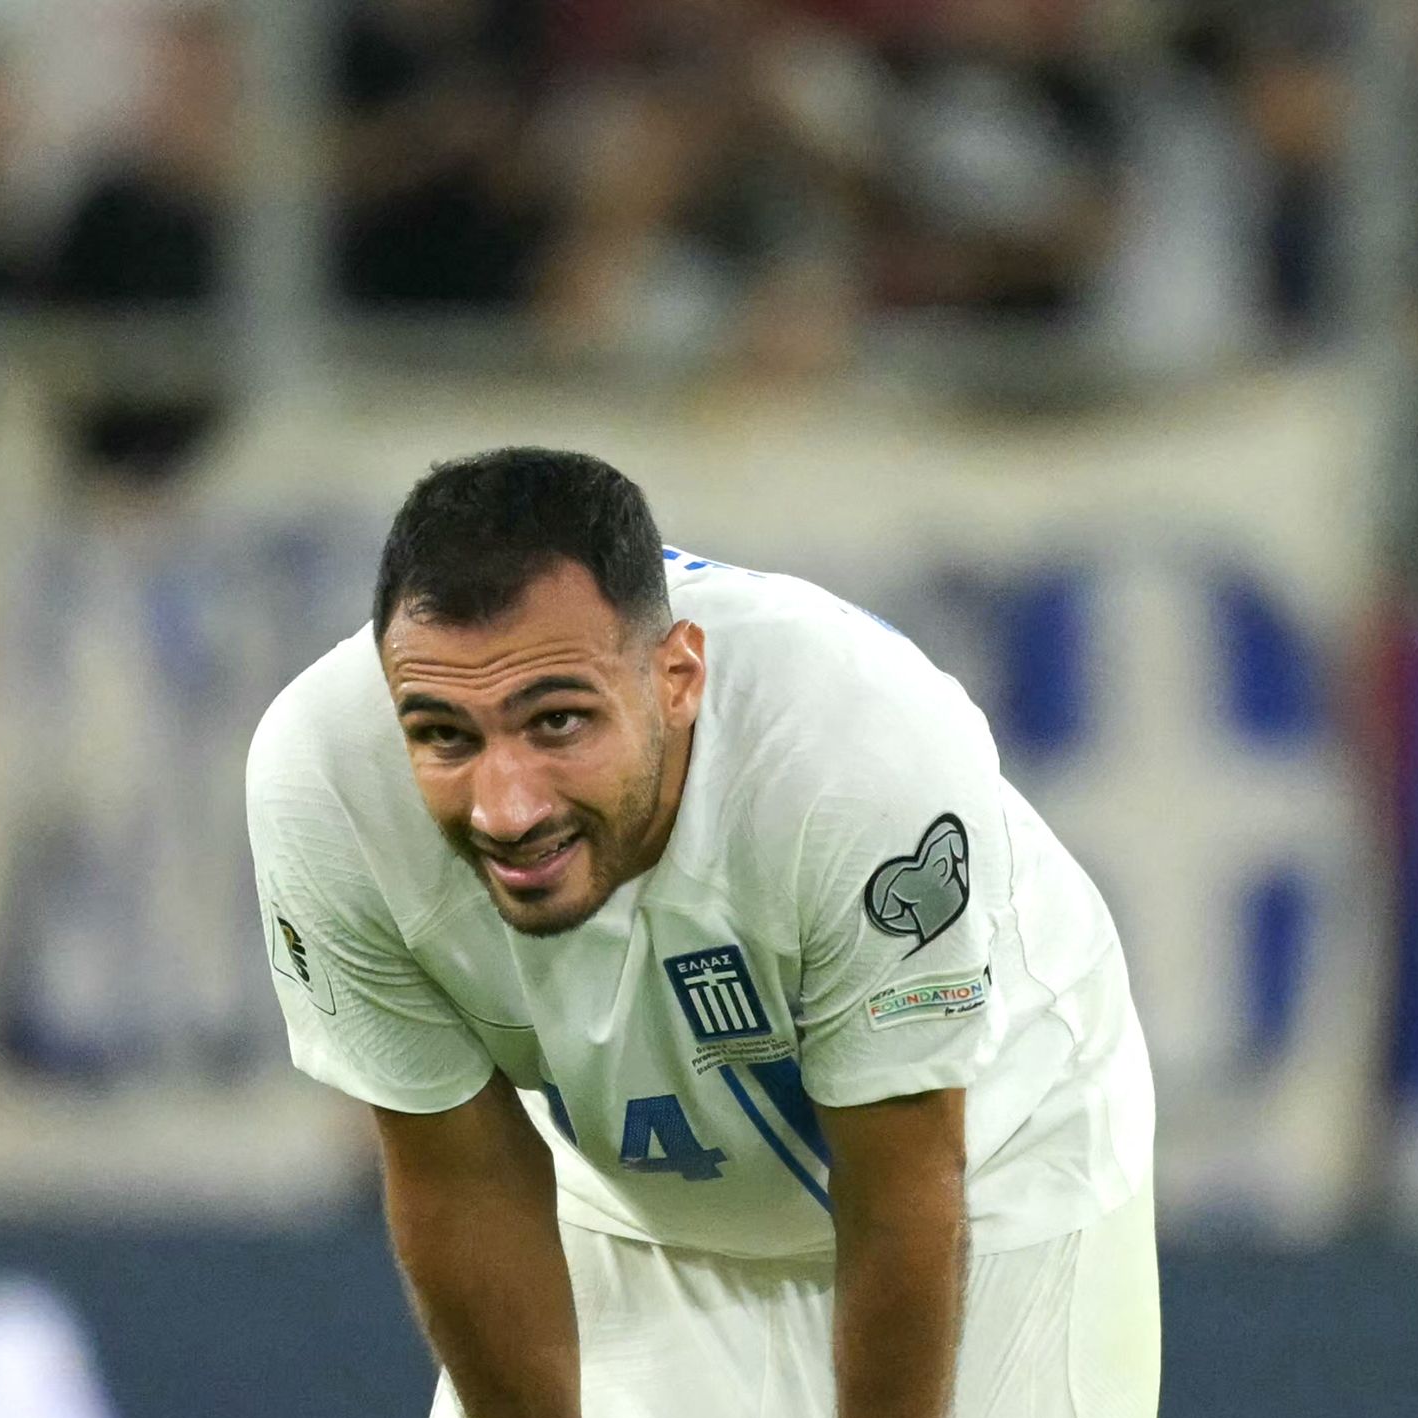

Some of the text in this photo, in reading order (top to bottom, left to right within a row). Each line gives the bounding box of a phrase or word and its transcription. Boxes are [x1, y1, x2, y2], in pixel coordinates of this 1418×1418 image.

[677, 954, 732, 973] ΕΛΛΑΣ
[871, 982, 983, 1016] FOUNDATION
[619, 1094, 728, 1181] 4
